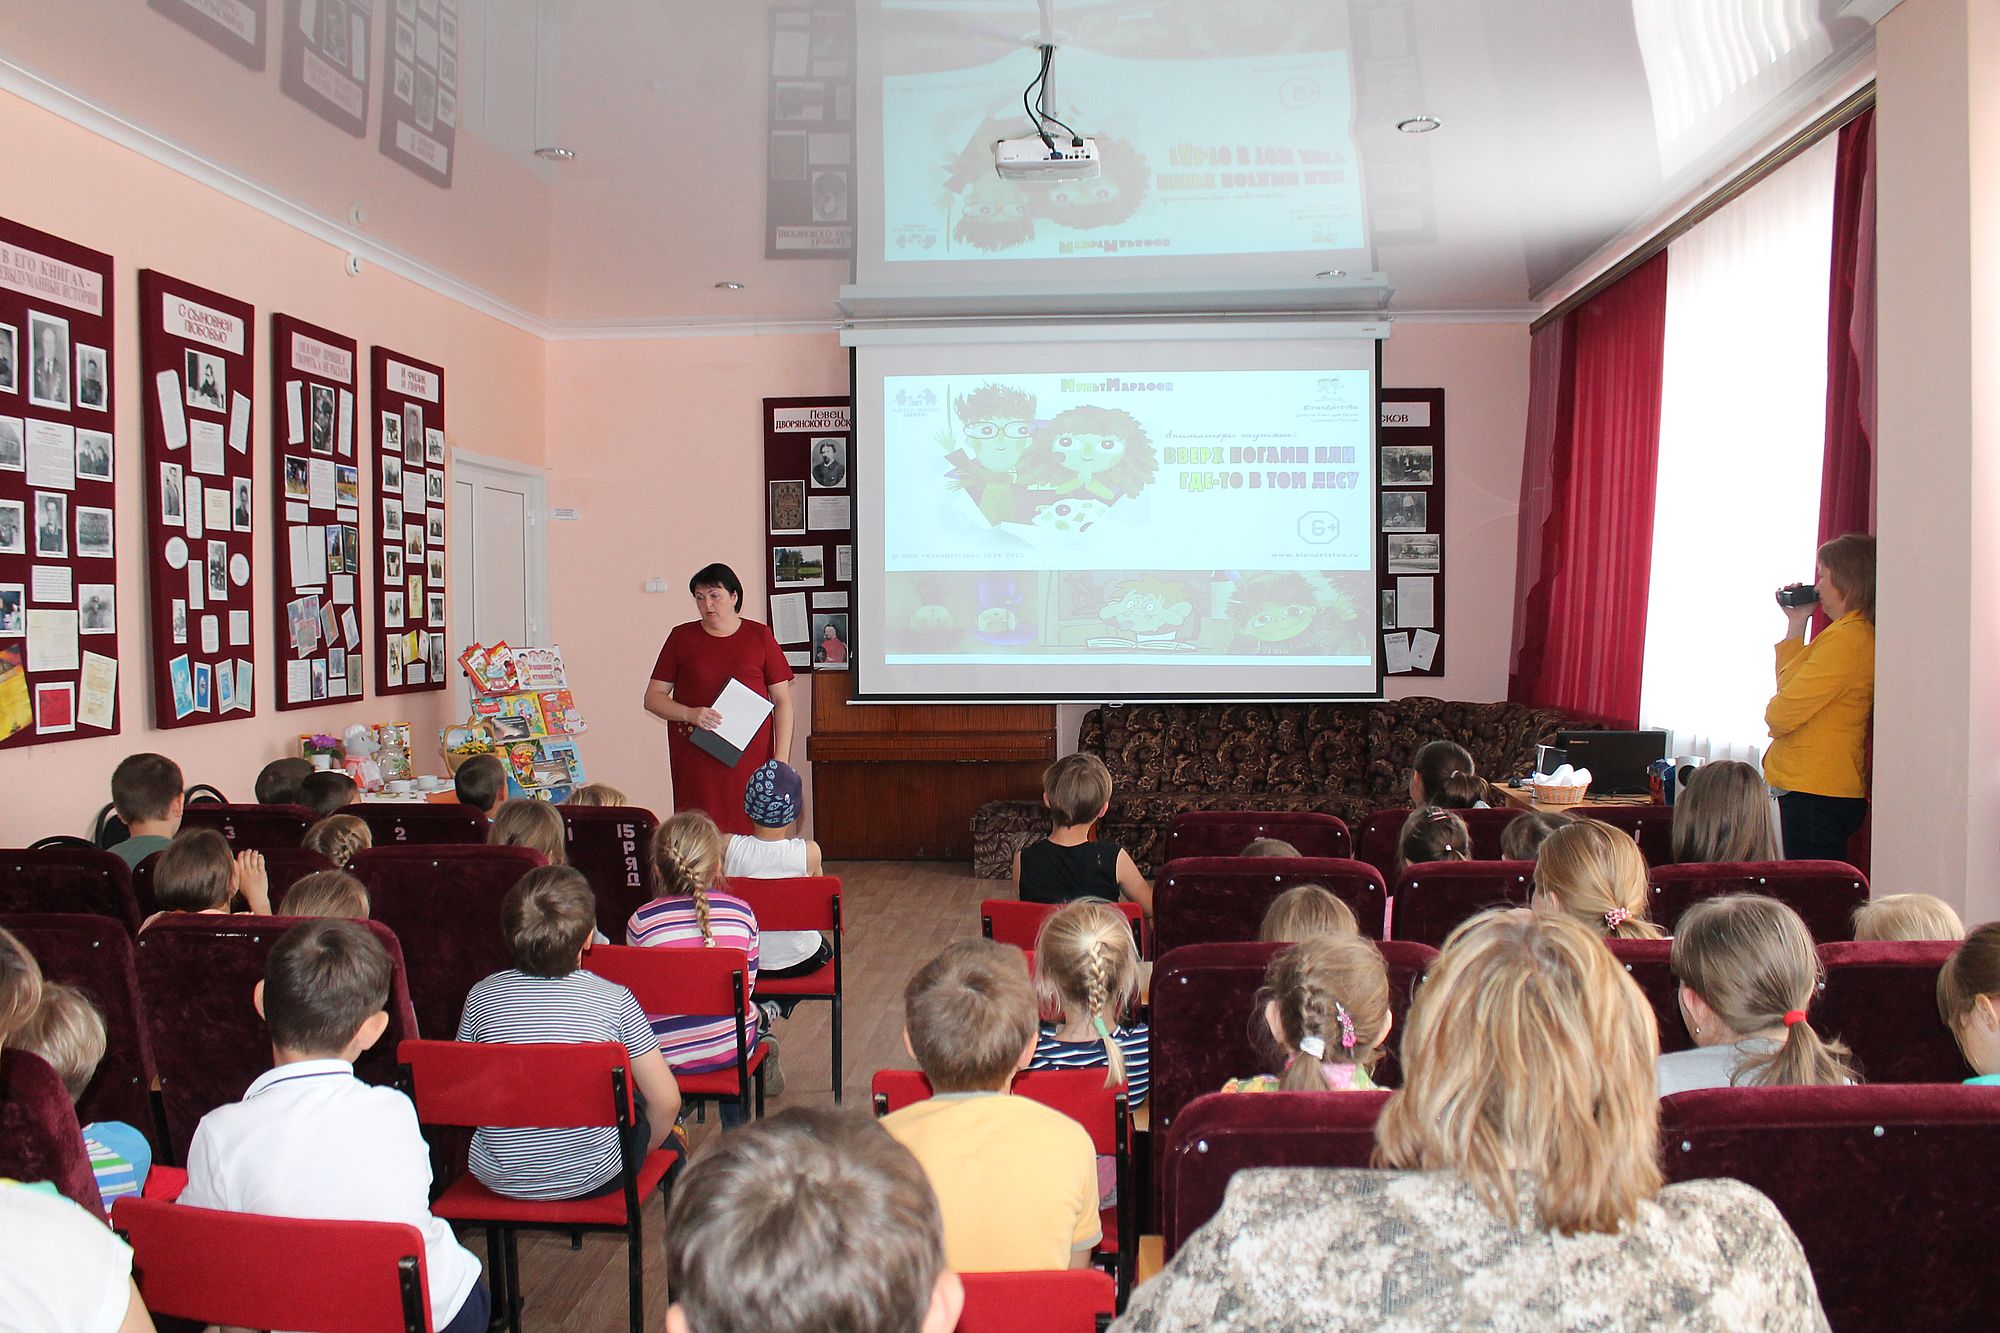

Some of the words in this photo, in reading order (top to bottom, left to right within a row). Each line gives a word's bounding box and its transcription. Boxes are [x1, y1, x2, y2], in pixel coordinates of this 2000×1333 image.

[15, 252, 37, 273] ЕГО
[810, 409, 845, 420] Певец
[776, 419, 831, 430] ДВОРЯНСКОГО
[1163, 446, 1225, 464] ВВЕРХ
[1229, 446, 1309, 464] НОГАМИ
[1314, 446, 1356, 464] ИЛИ
[1179, 471, 1244, 492] ГДЕ-ТО
[1248, 471, 1262, 489] В
[1267, 471, 1307, 489] ТОМ
[1311, 471, 1360, 489] ЛЕСУ
[1311, 519, 1337, 536] 6+
[224, 826, 236, 840] 3
[394, 826, 407, 841] 2
[616, 823, 636, 839] 15
